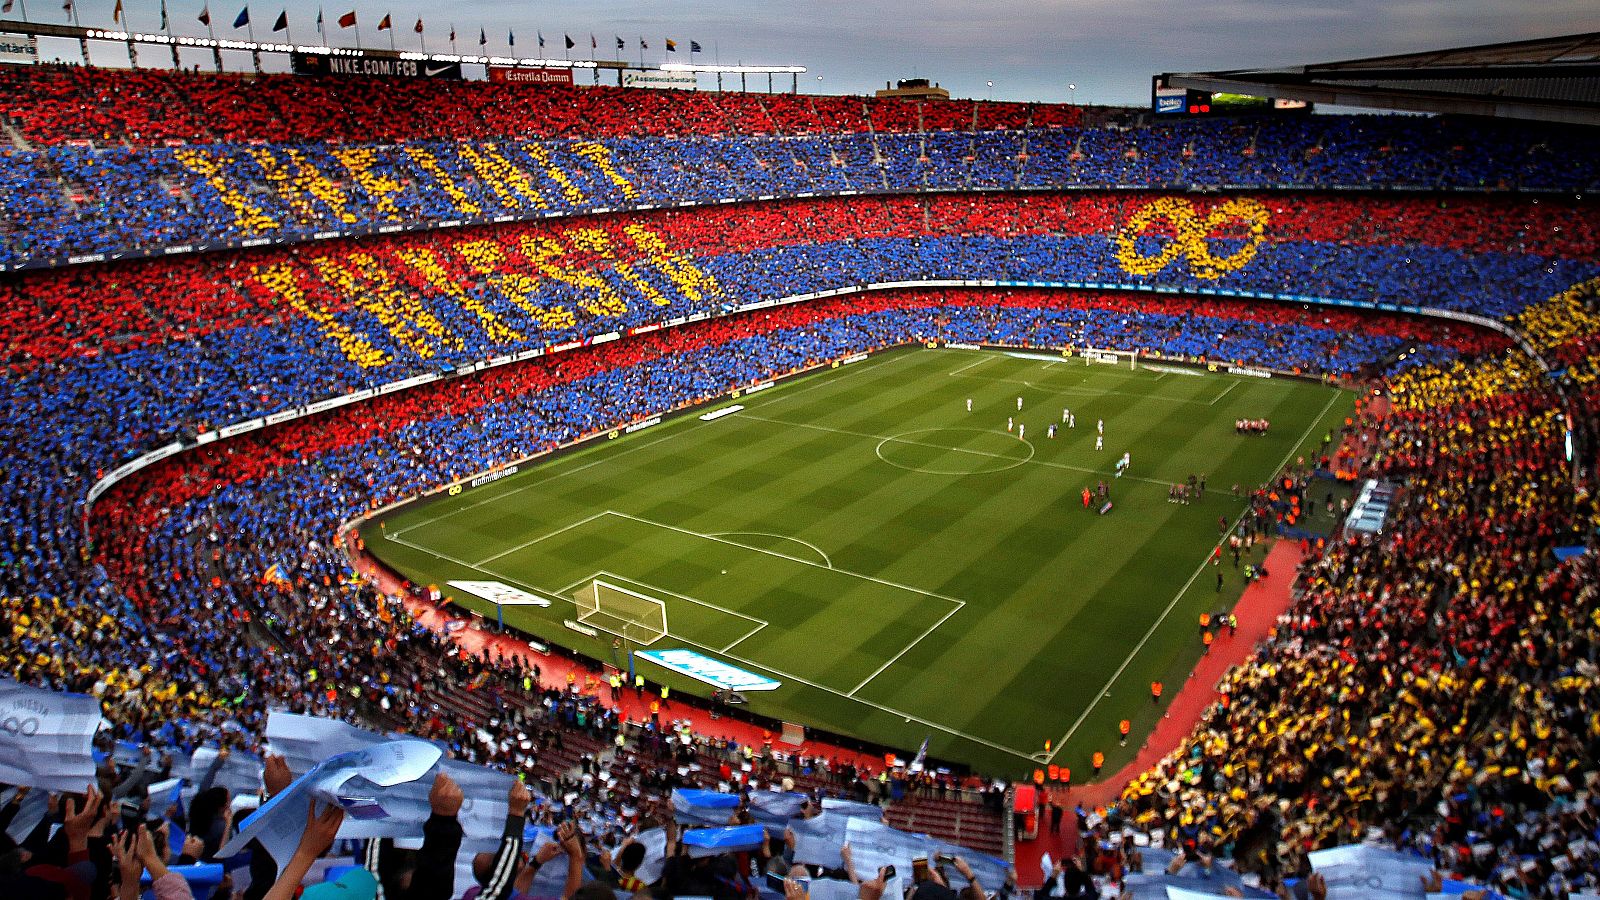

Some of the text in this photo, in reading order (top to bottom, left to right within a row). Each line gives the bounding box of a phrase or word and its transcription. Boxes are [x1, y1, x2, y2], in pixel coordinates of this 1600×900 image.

[329, 58, 418, 77] NIKE.COM/FCB
[505, 70, 569, 82] Estrella Damm
